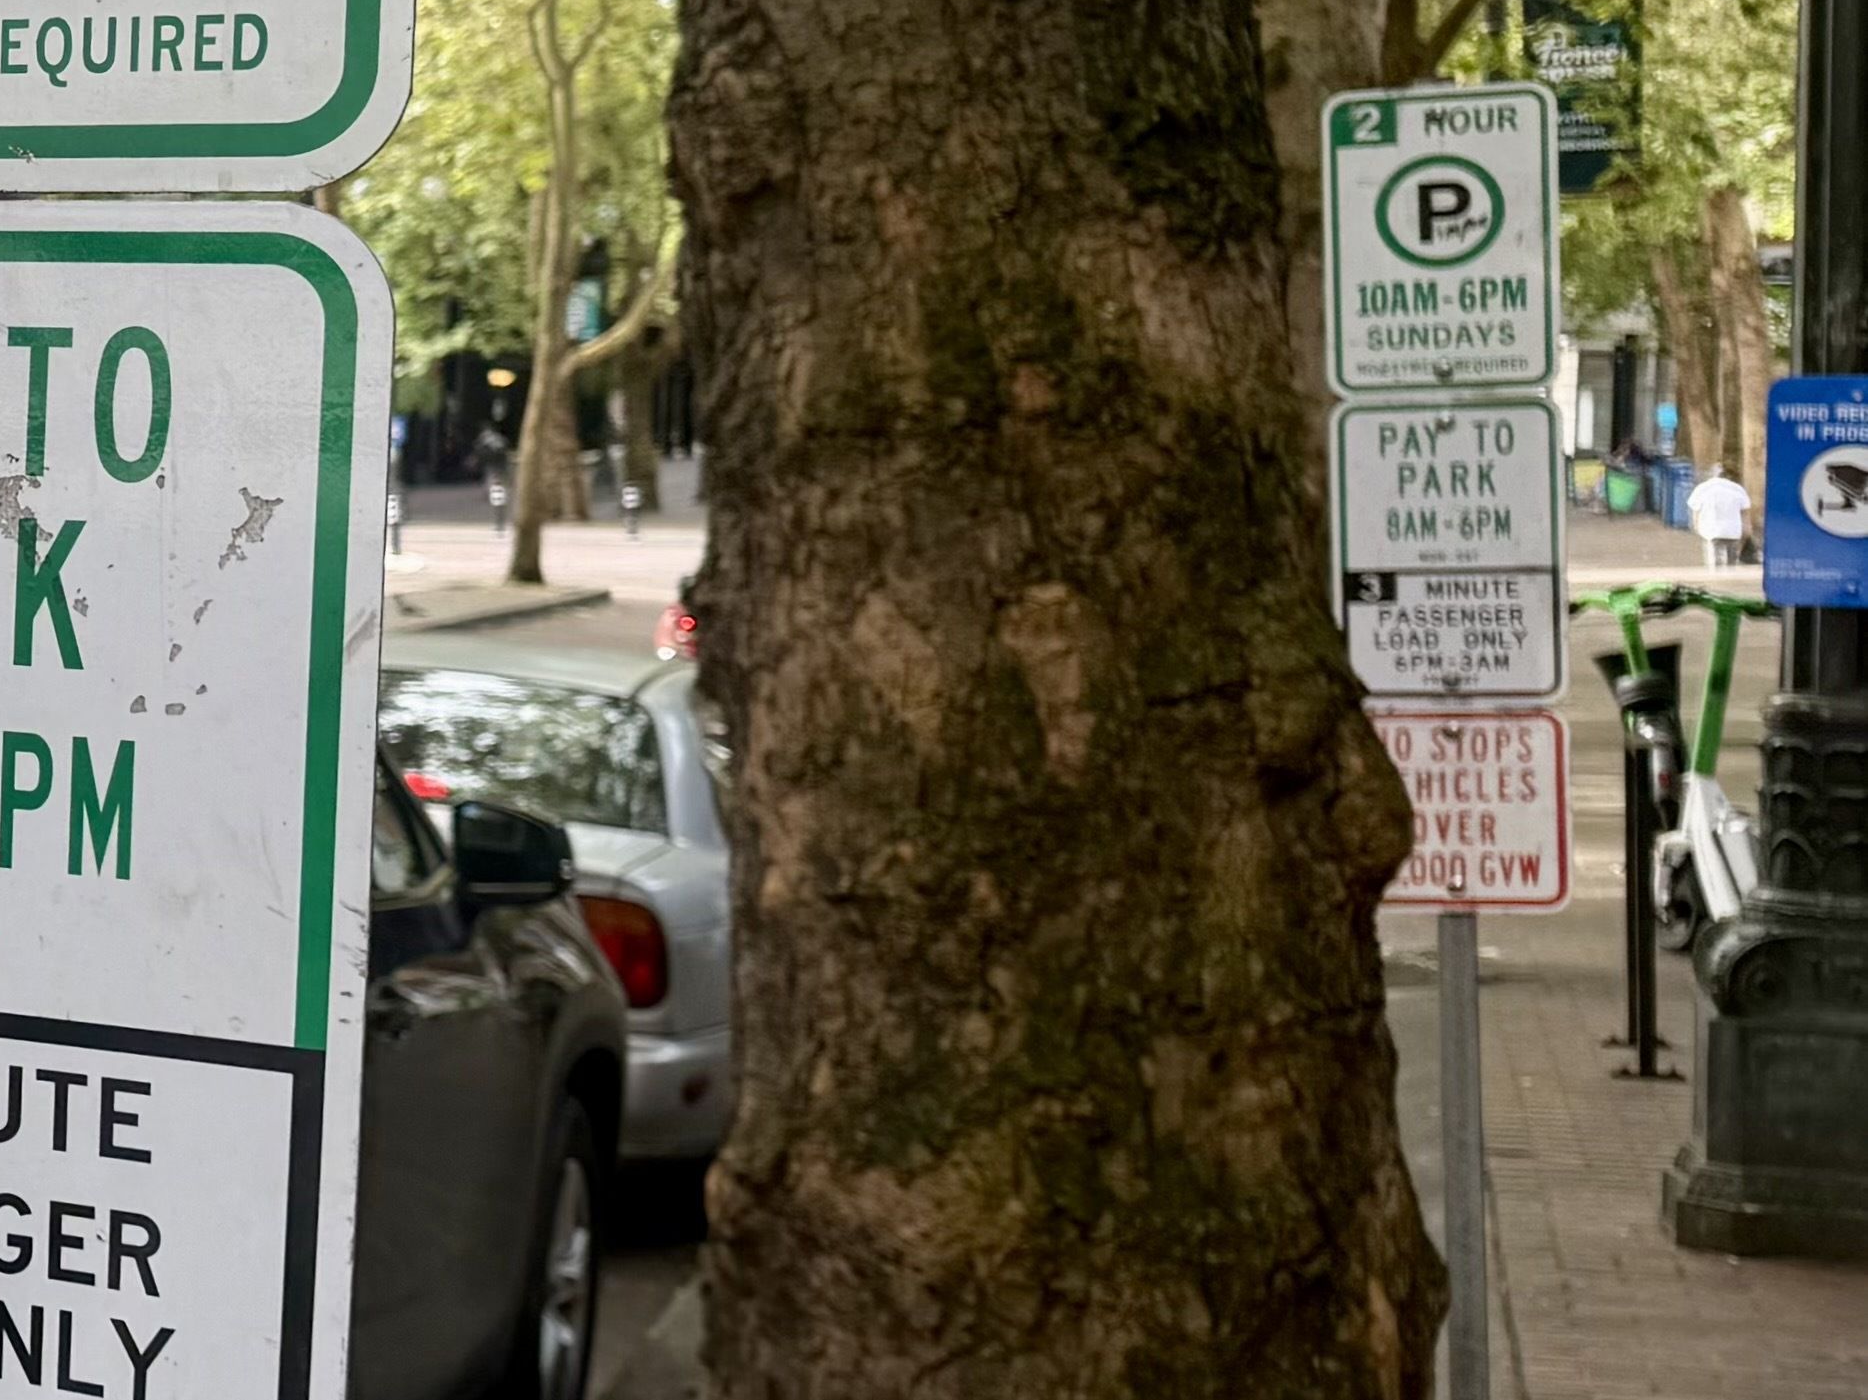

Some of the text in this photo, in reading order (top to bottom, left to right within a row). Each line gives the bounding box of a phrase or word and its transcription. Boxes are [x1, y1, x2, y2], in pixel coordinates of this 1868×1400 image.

[1350, 103, 1382, 142] 2
[1422, 105, 1519, 137] HOUR
[1417, 182, 1472, 244] P
[1356, 276, 1528, 318] 10AM-6PM
[1366, 319, 1517, 351] SUNDAYS
[7, 325, 174, 483] TO
[1777, 402, 1830, 423] VIDEO
[1377, 417, 1516, 459] PAY TO
[1796, 425, 1815, 441] IN
[1397, 460, 1497, 500] PARK
[1385, 505, 1513, 542] 8AM-6PM
[1359, 574, 1520, 604] 3 MINUTE
[1378, 604, 1524, 629] PASSENGER
[1373, 629, 1529, 651] LOAD ONLY
[1430, 726, 1534, 764] STOPS
[1401, 767, 1537, 804] HICLES
[1413, 810, 1497, 846] OVER
[1401, 851, 1541, 888] ,000 GVW
